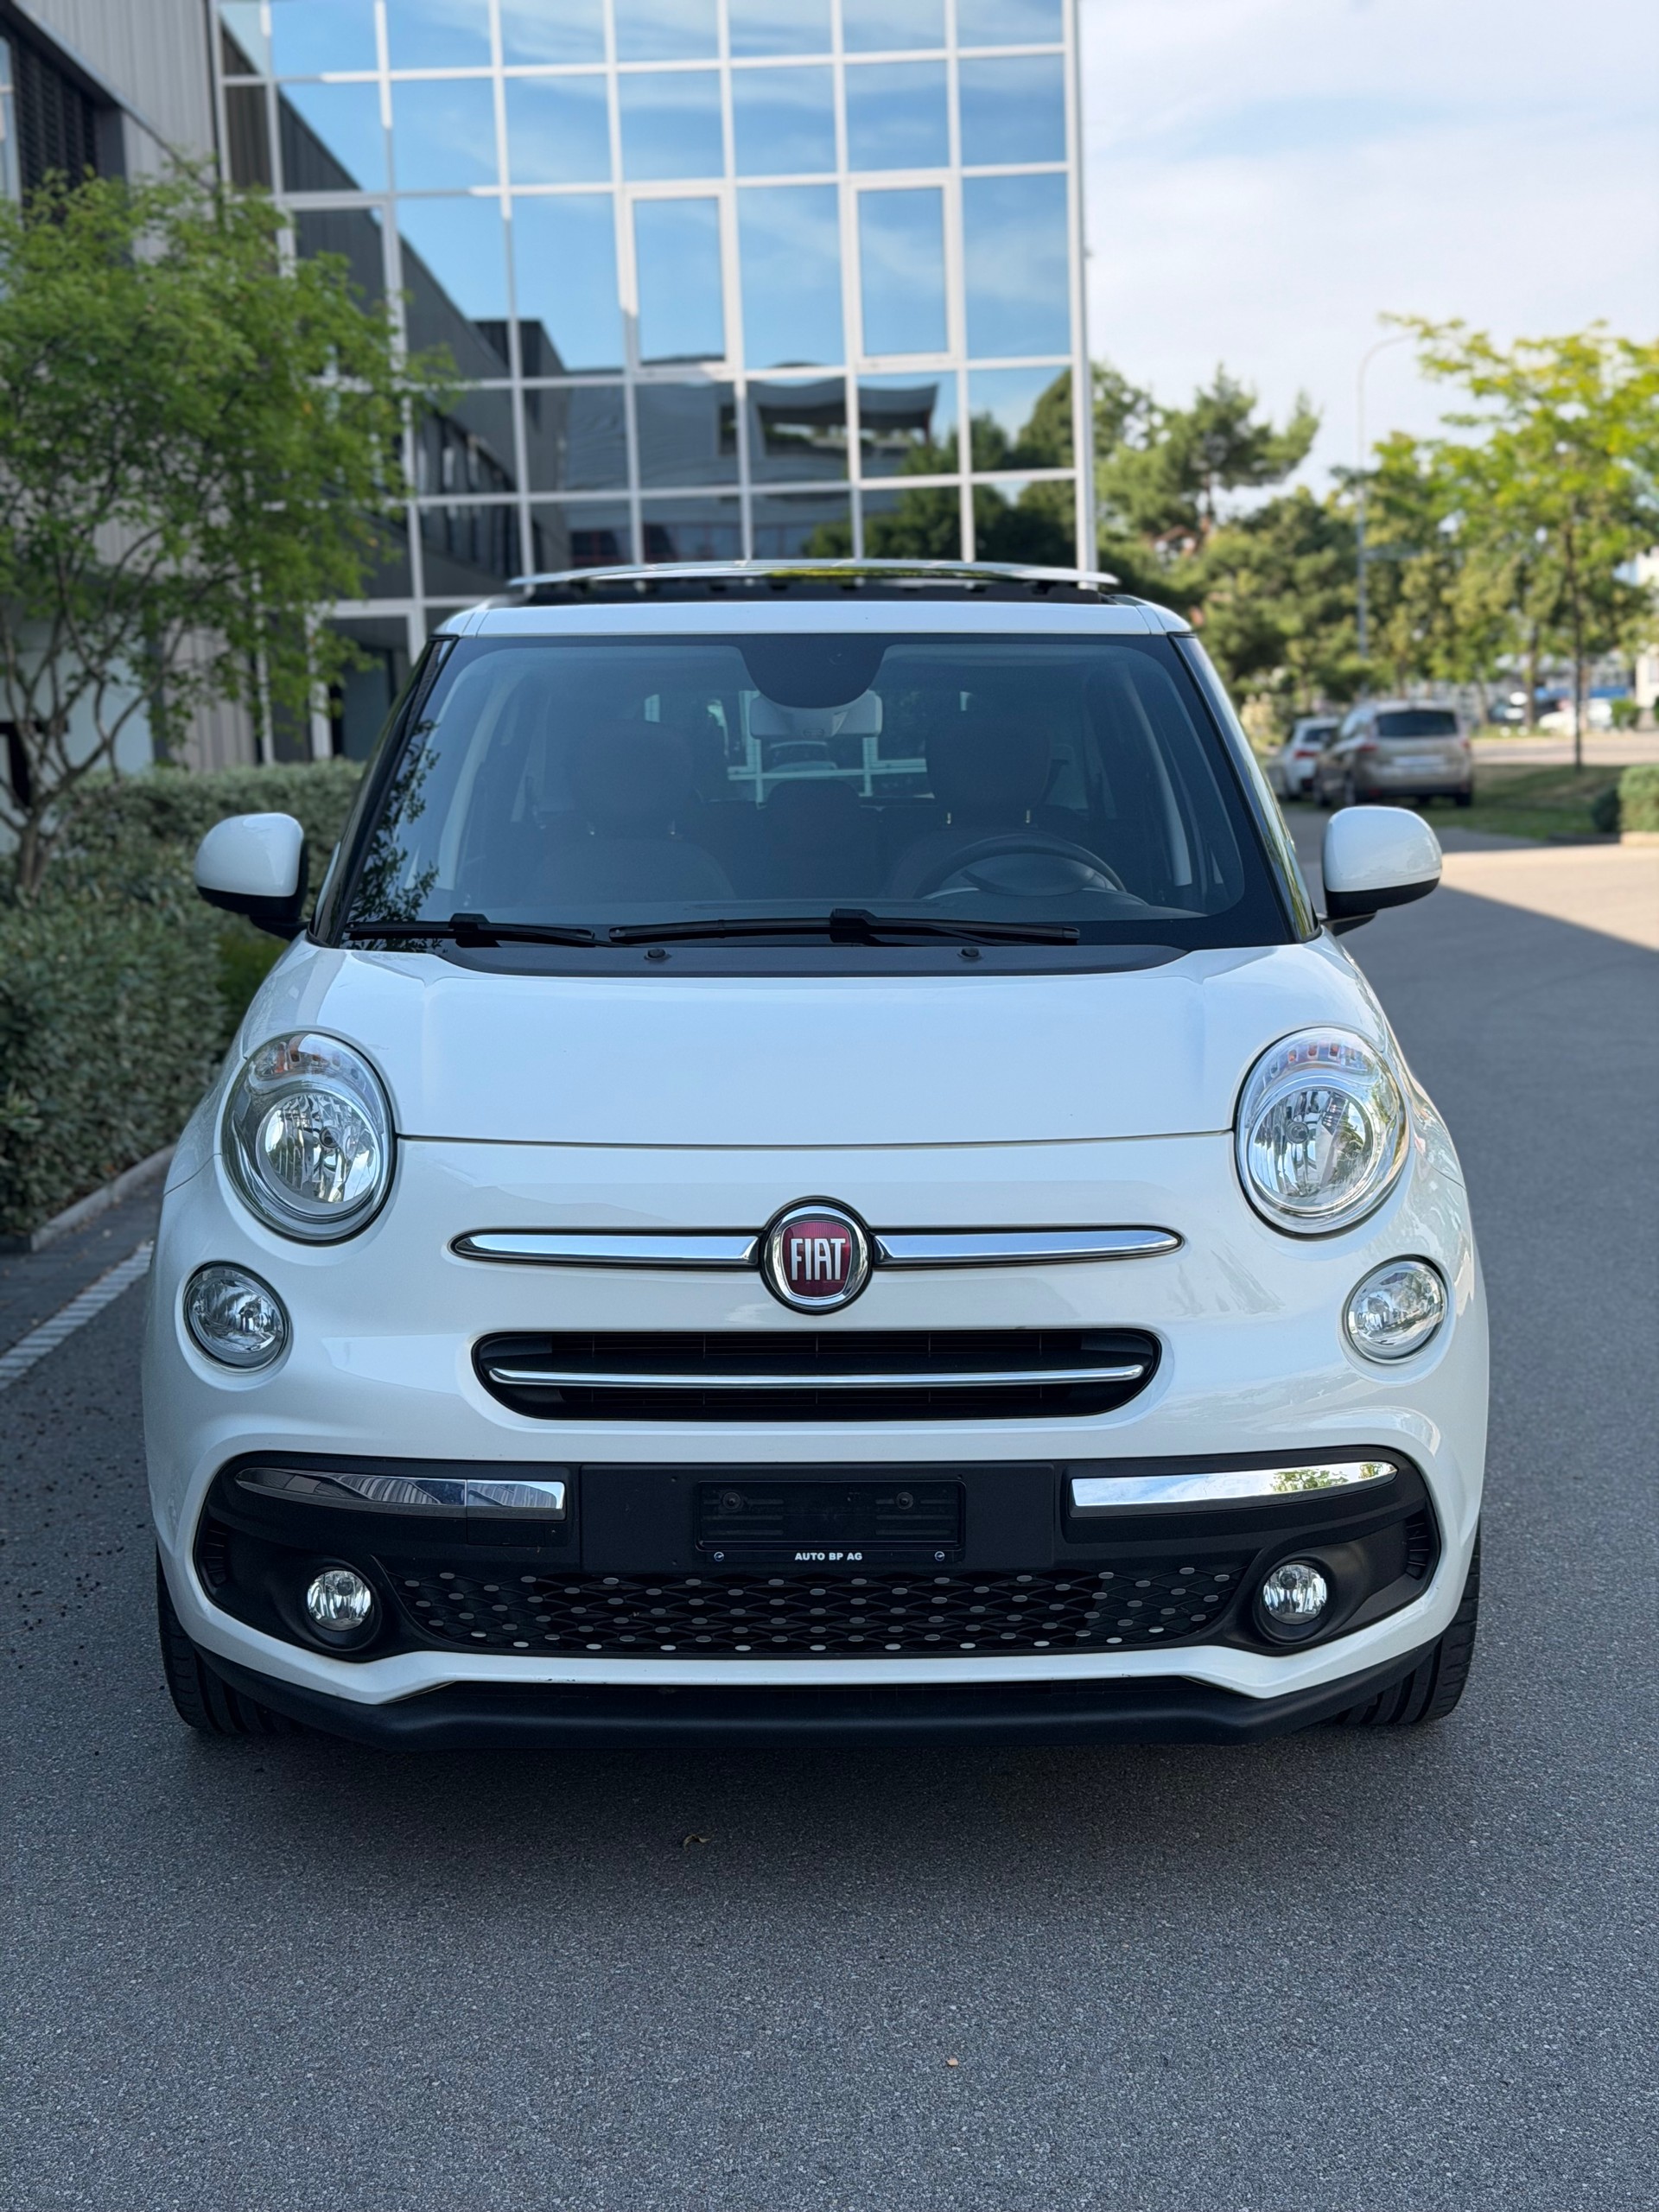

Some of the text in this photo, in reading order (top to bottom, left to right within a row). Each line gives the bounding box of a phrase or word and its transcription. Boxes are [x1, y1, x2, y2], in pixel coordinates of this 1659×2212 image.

[791, 1238, 846, 1281] FIAT
[795, 1552, 862, 1560] AUTO BP AG
